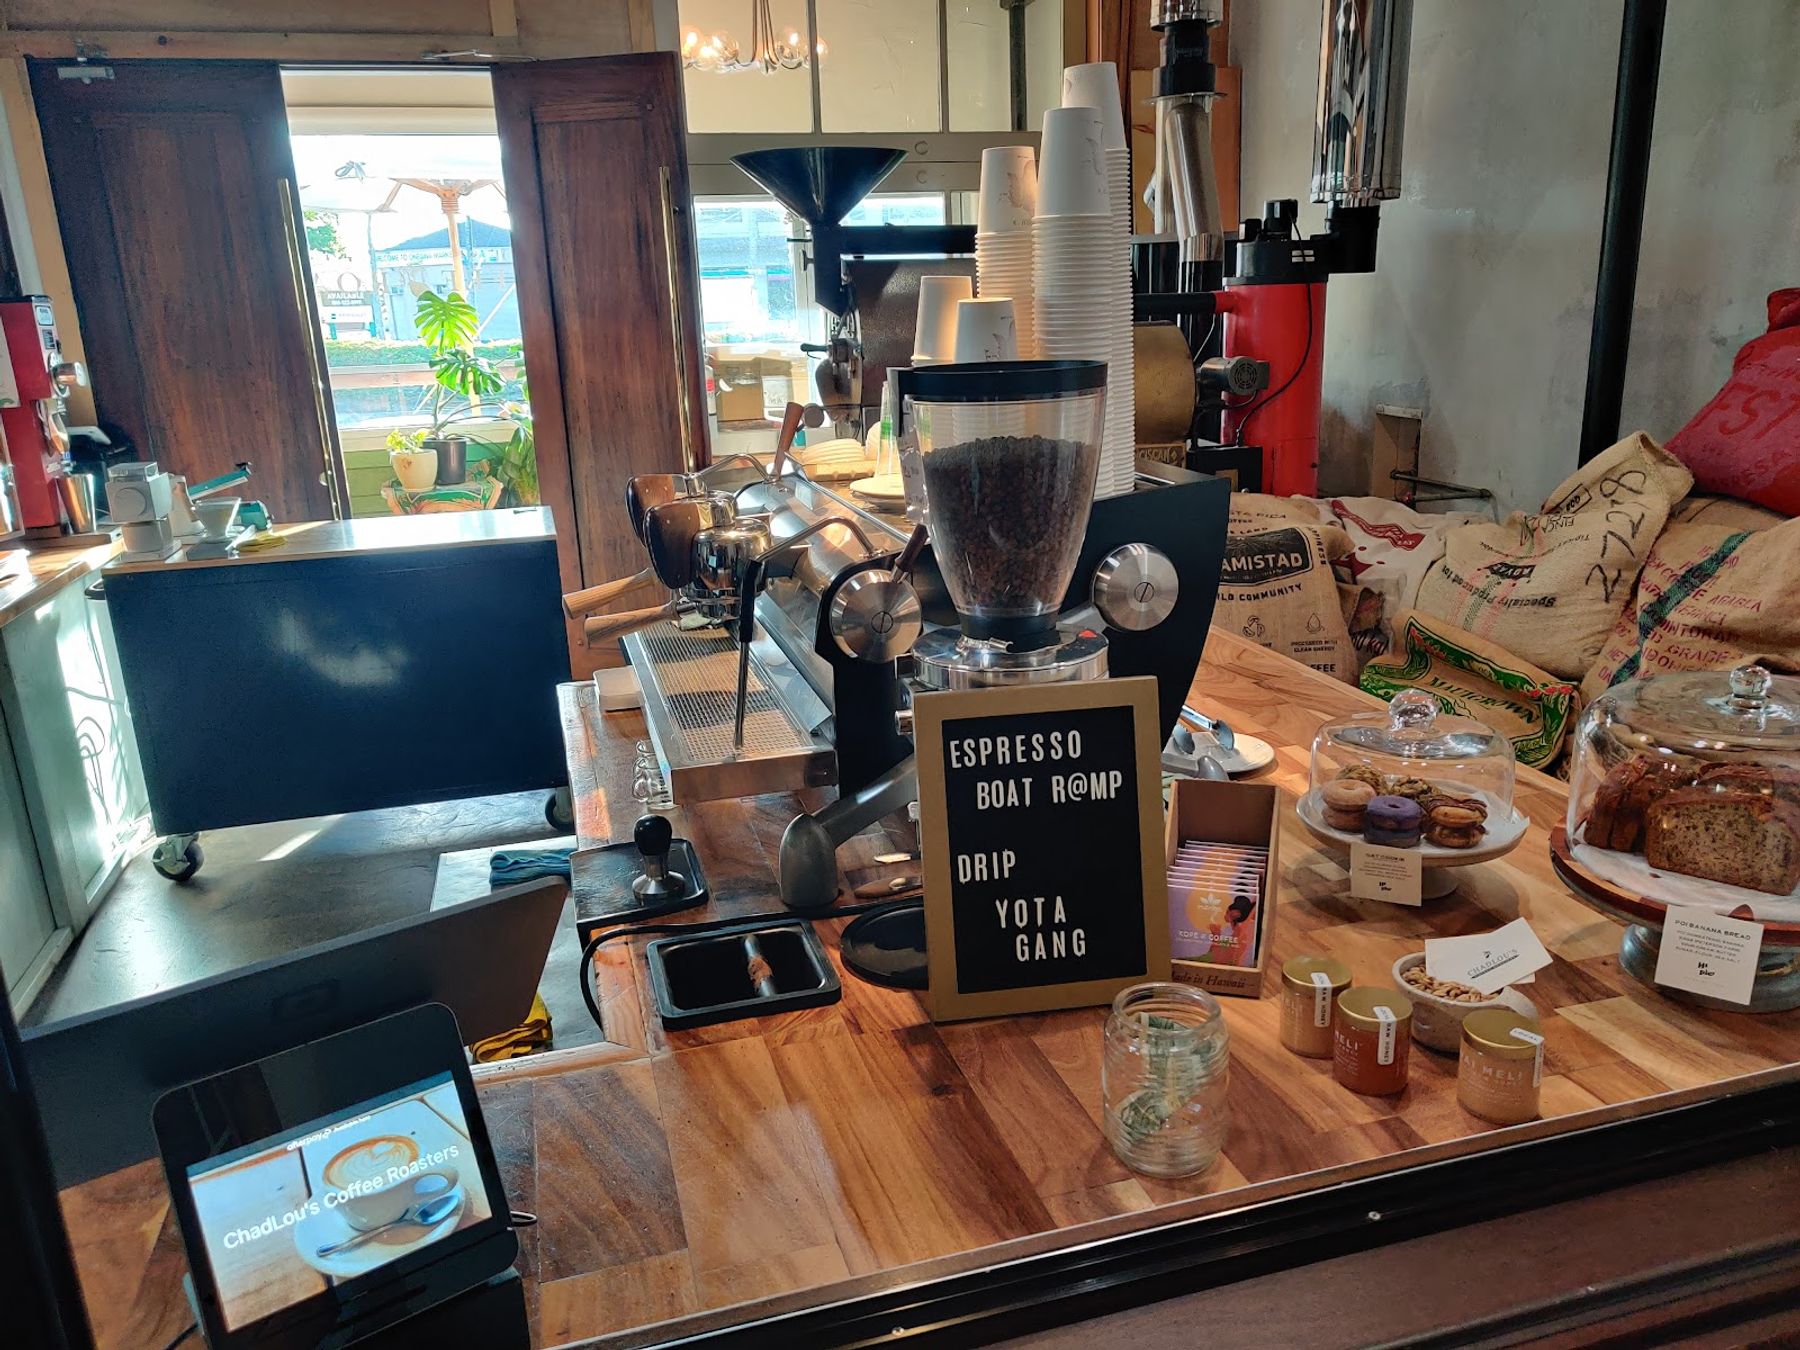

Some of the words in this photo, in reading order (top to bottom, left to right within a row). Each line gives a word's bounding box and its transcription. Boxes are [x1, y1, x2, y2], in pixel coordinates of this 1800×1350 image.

[1221, 552, 1304, 572] AMISTAD
[1239, 583, 1303, 601] COMMUNITY
[950, 730, 1082, 769] ESPRESSO
[976, 777, 1033, 810] BOAT
[1051, 770, 1123, 803] R@MP
[957, 849, 1016, 884] DRIP
[995, 896, 1066, 929] YOTA
[1178, 930, 1201, 939] KOPE
[1209, 932, 1238, 943] COFFEE
[1674, 919, 1688, 927] POI
[1689, 923, 1722, 935] BANANA
[1724, 930, 1751, 940] BREAD
[1015, 928, 1086, 962] GANG
[1467, 948, 1520, 978] CHADLOU'S
[1193, 973, 1203, 984] in
[1206, 974, 1247, 989] Hawaii
[1320, 1003, 1328, 1026] HONEY
[1482, 1066, 1523, 1081] MELI
[286, 1132, 323, 1151] afterpay
[223, 1199, 321, 1249] ChadLou's
[324, 1175, 384, 1208] Coffee
[388, 1144, 459, 1180] Roasters
